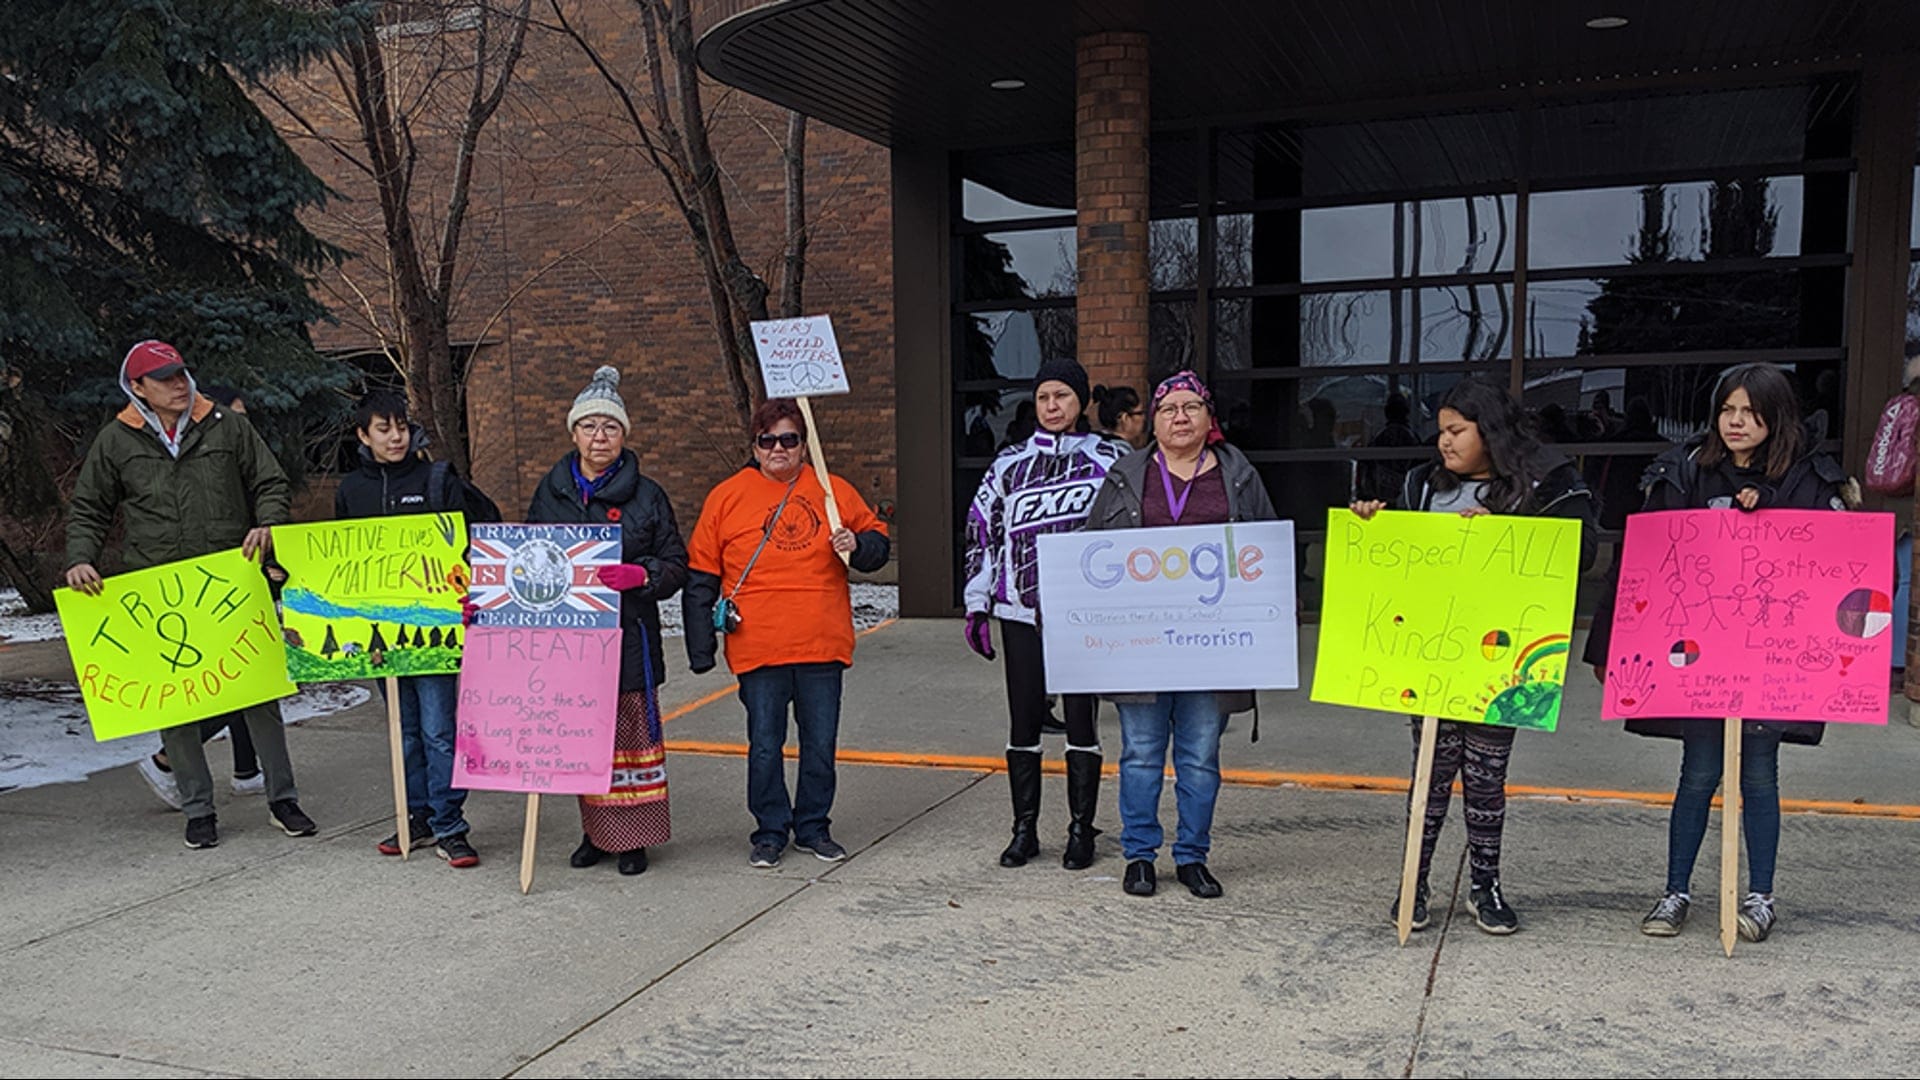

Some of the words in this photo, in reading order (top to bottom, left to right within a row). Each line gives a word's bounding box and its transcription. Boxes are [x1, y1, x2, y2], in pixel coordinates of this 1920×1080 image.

[761, 321, 813, 335] EVERY
[777, 336, 824, 348] CHILD
[769, 348, 836, 363] MATTERS
[1872, 422, 1894, 476] Reebok
[1013, 484, 1093, 524] FXR
[473, 525, 557, 540] TREATY
[1667, 513, 1700, 543] US
[1718, 512, 1815, 543] Natives
[306, 525, 389, 561] NATIVE
[1344, 517, 1479, 580] Respect
[1480, 523, 1565, 579] ALL
[324, 551, 449, 595] MATTER!!!
[1080, 525, 1265, 606] Google
[1659, 543, 1711, 576] Are
[90, 565, 251, 655] TRUTH
[475, 611, 601, 627] TERRITORY
[1164, 627, 1253, 648] Terrorism
[1362, 593, 1469, 662] Kinds
[1744, 629, 1799, 651] Love
[81, 610, 277, 710] RECIPROCITY
[474, 629, 617, 665] TREATY
[1765, 651, 1792, 665] then
[528, 665, 546, 694] 6
[488, 688, 523, 715] Long
[527, 695, 545, 706] as
[552, 691, 574, 707] the
[577, 693, 598, 708] Sun
[484, 720, 512, 747] Long
[519, 727, 532, 737] as
[537, 722, 553, 737] the
[557, 723, 594, 738] Grass
[480, 753, 511, 775] Long
